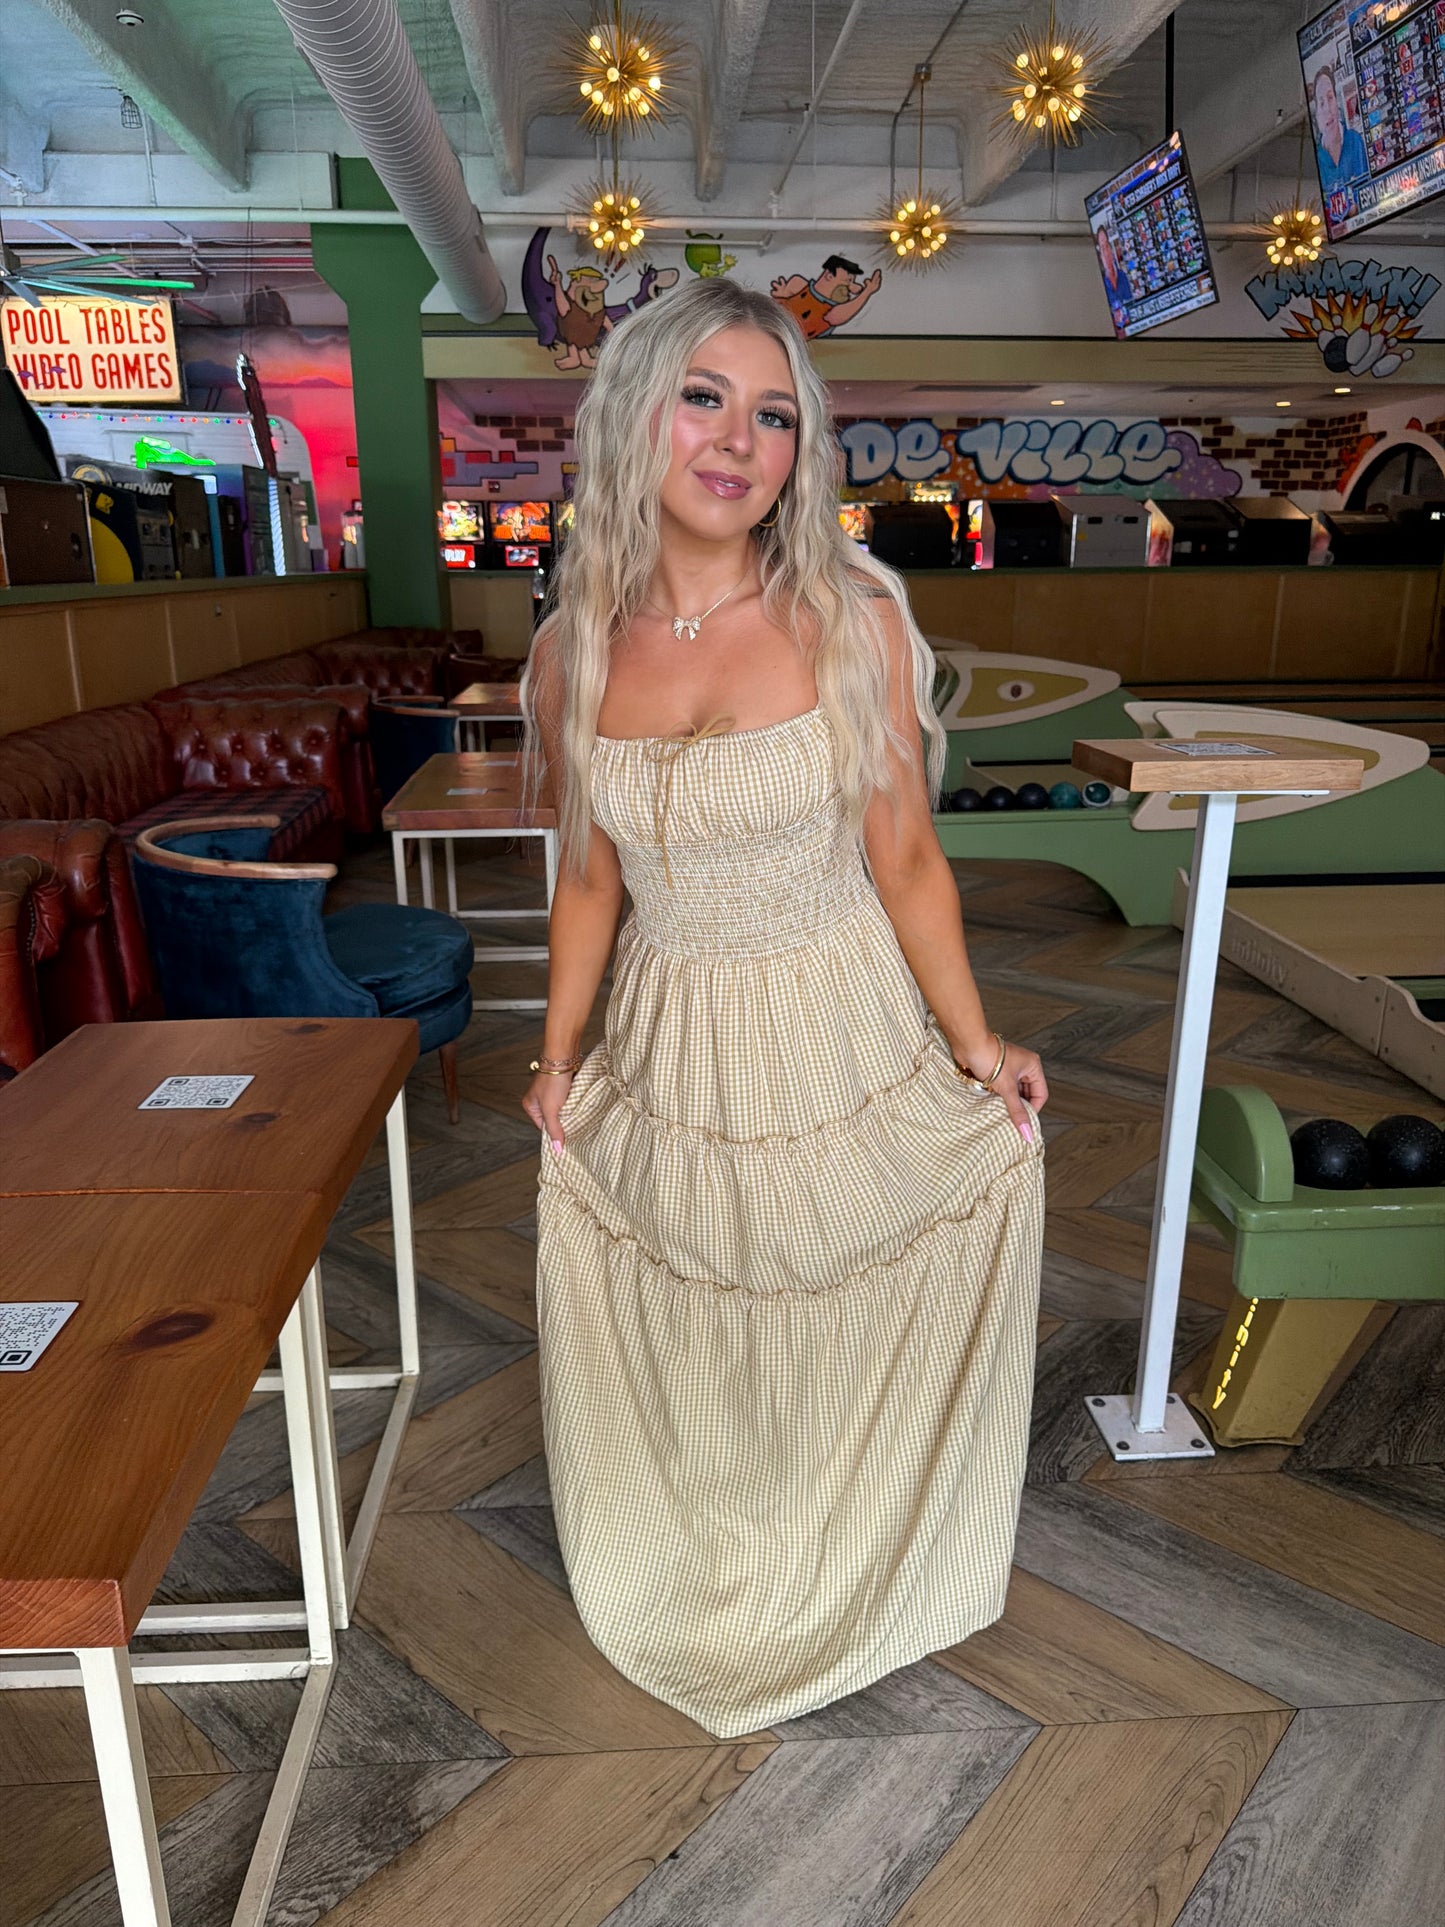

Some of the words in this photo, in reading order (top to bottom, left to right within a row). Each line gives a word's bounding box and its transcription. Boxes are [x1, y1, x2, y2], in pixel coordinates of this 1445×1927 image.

[6, 308, 70, 345] POOL
[79, 308, 167, 345] TABLES
[12, 353, 83, 390] VIDEO
[91, 353, 174, 390] GAMES
